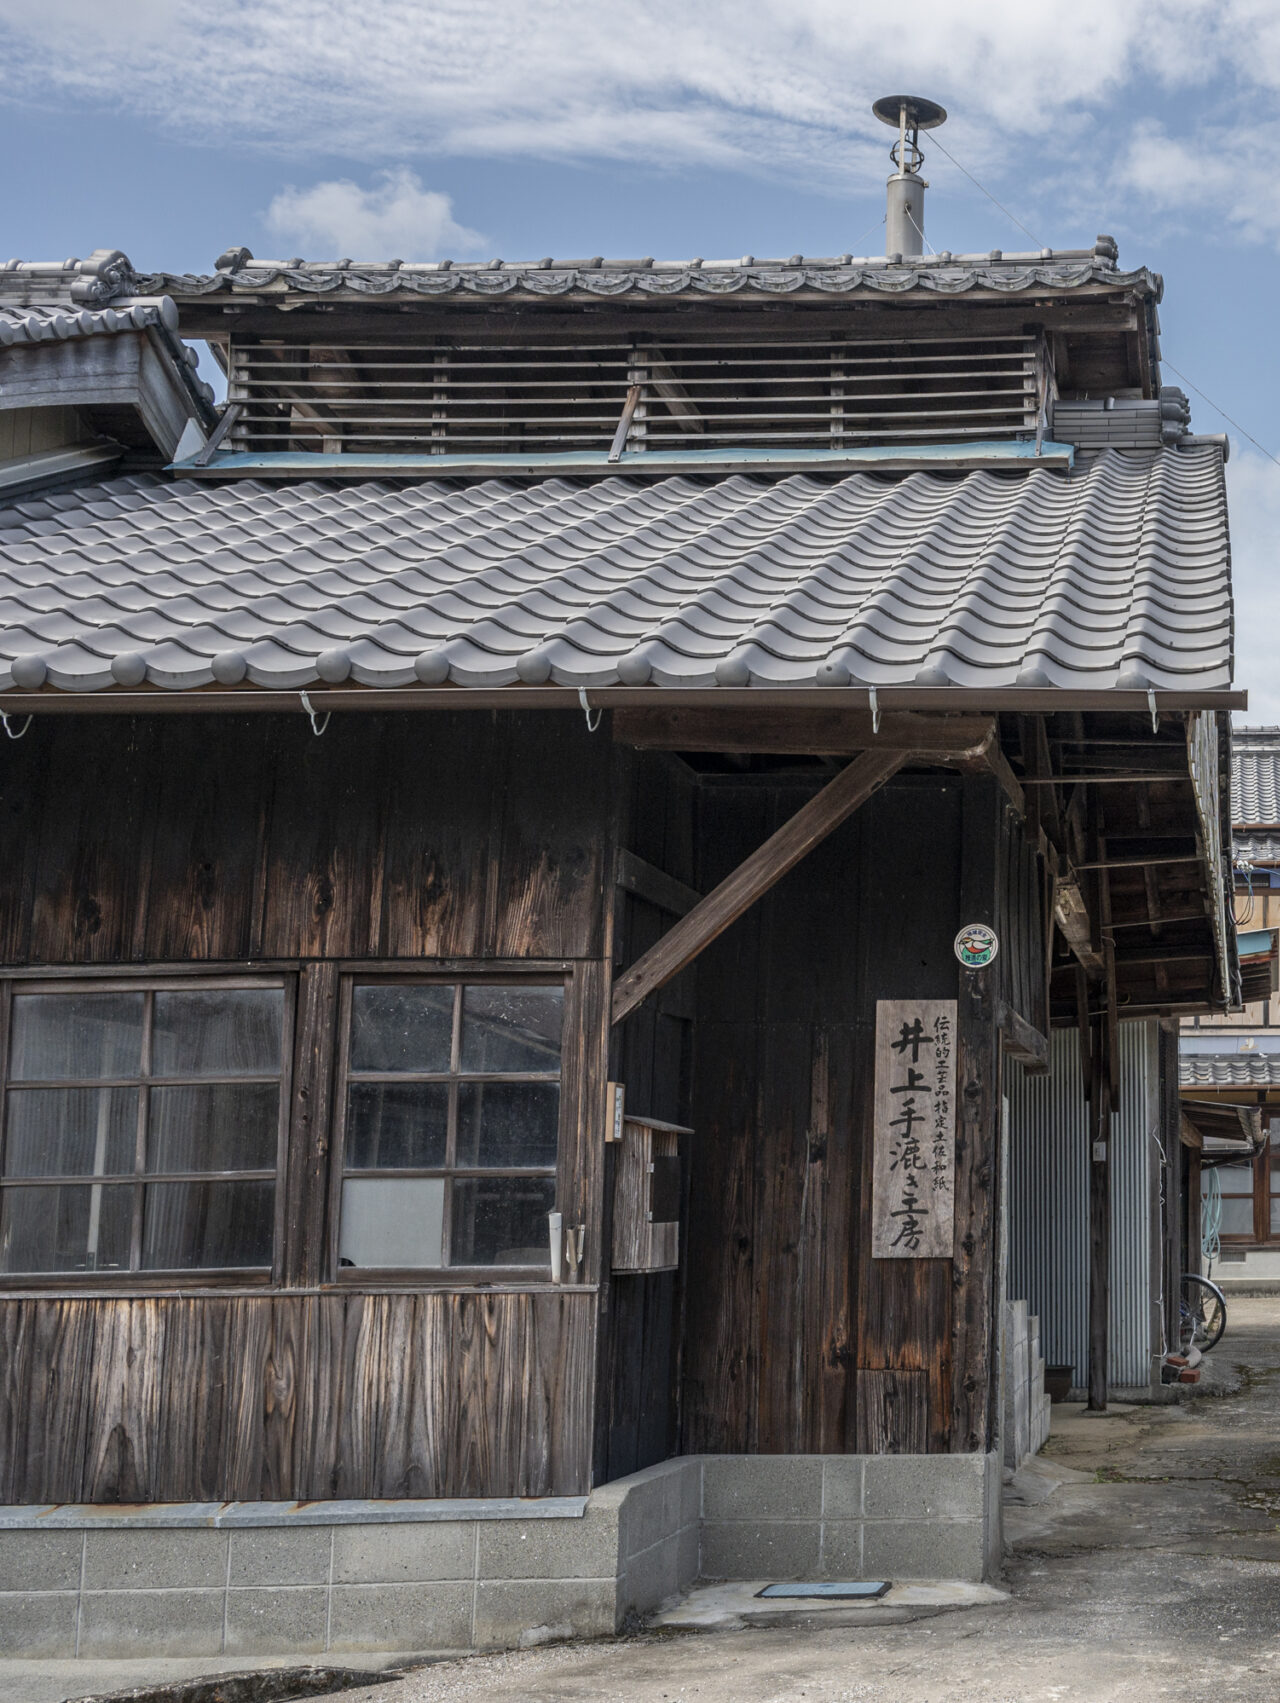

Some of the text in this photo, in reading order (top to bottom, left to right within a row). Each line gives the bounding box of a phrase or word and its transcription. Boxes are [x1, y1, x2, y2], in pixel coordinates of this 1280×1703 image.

[889, 1018, 934, 1250] 井上手漉き工房
